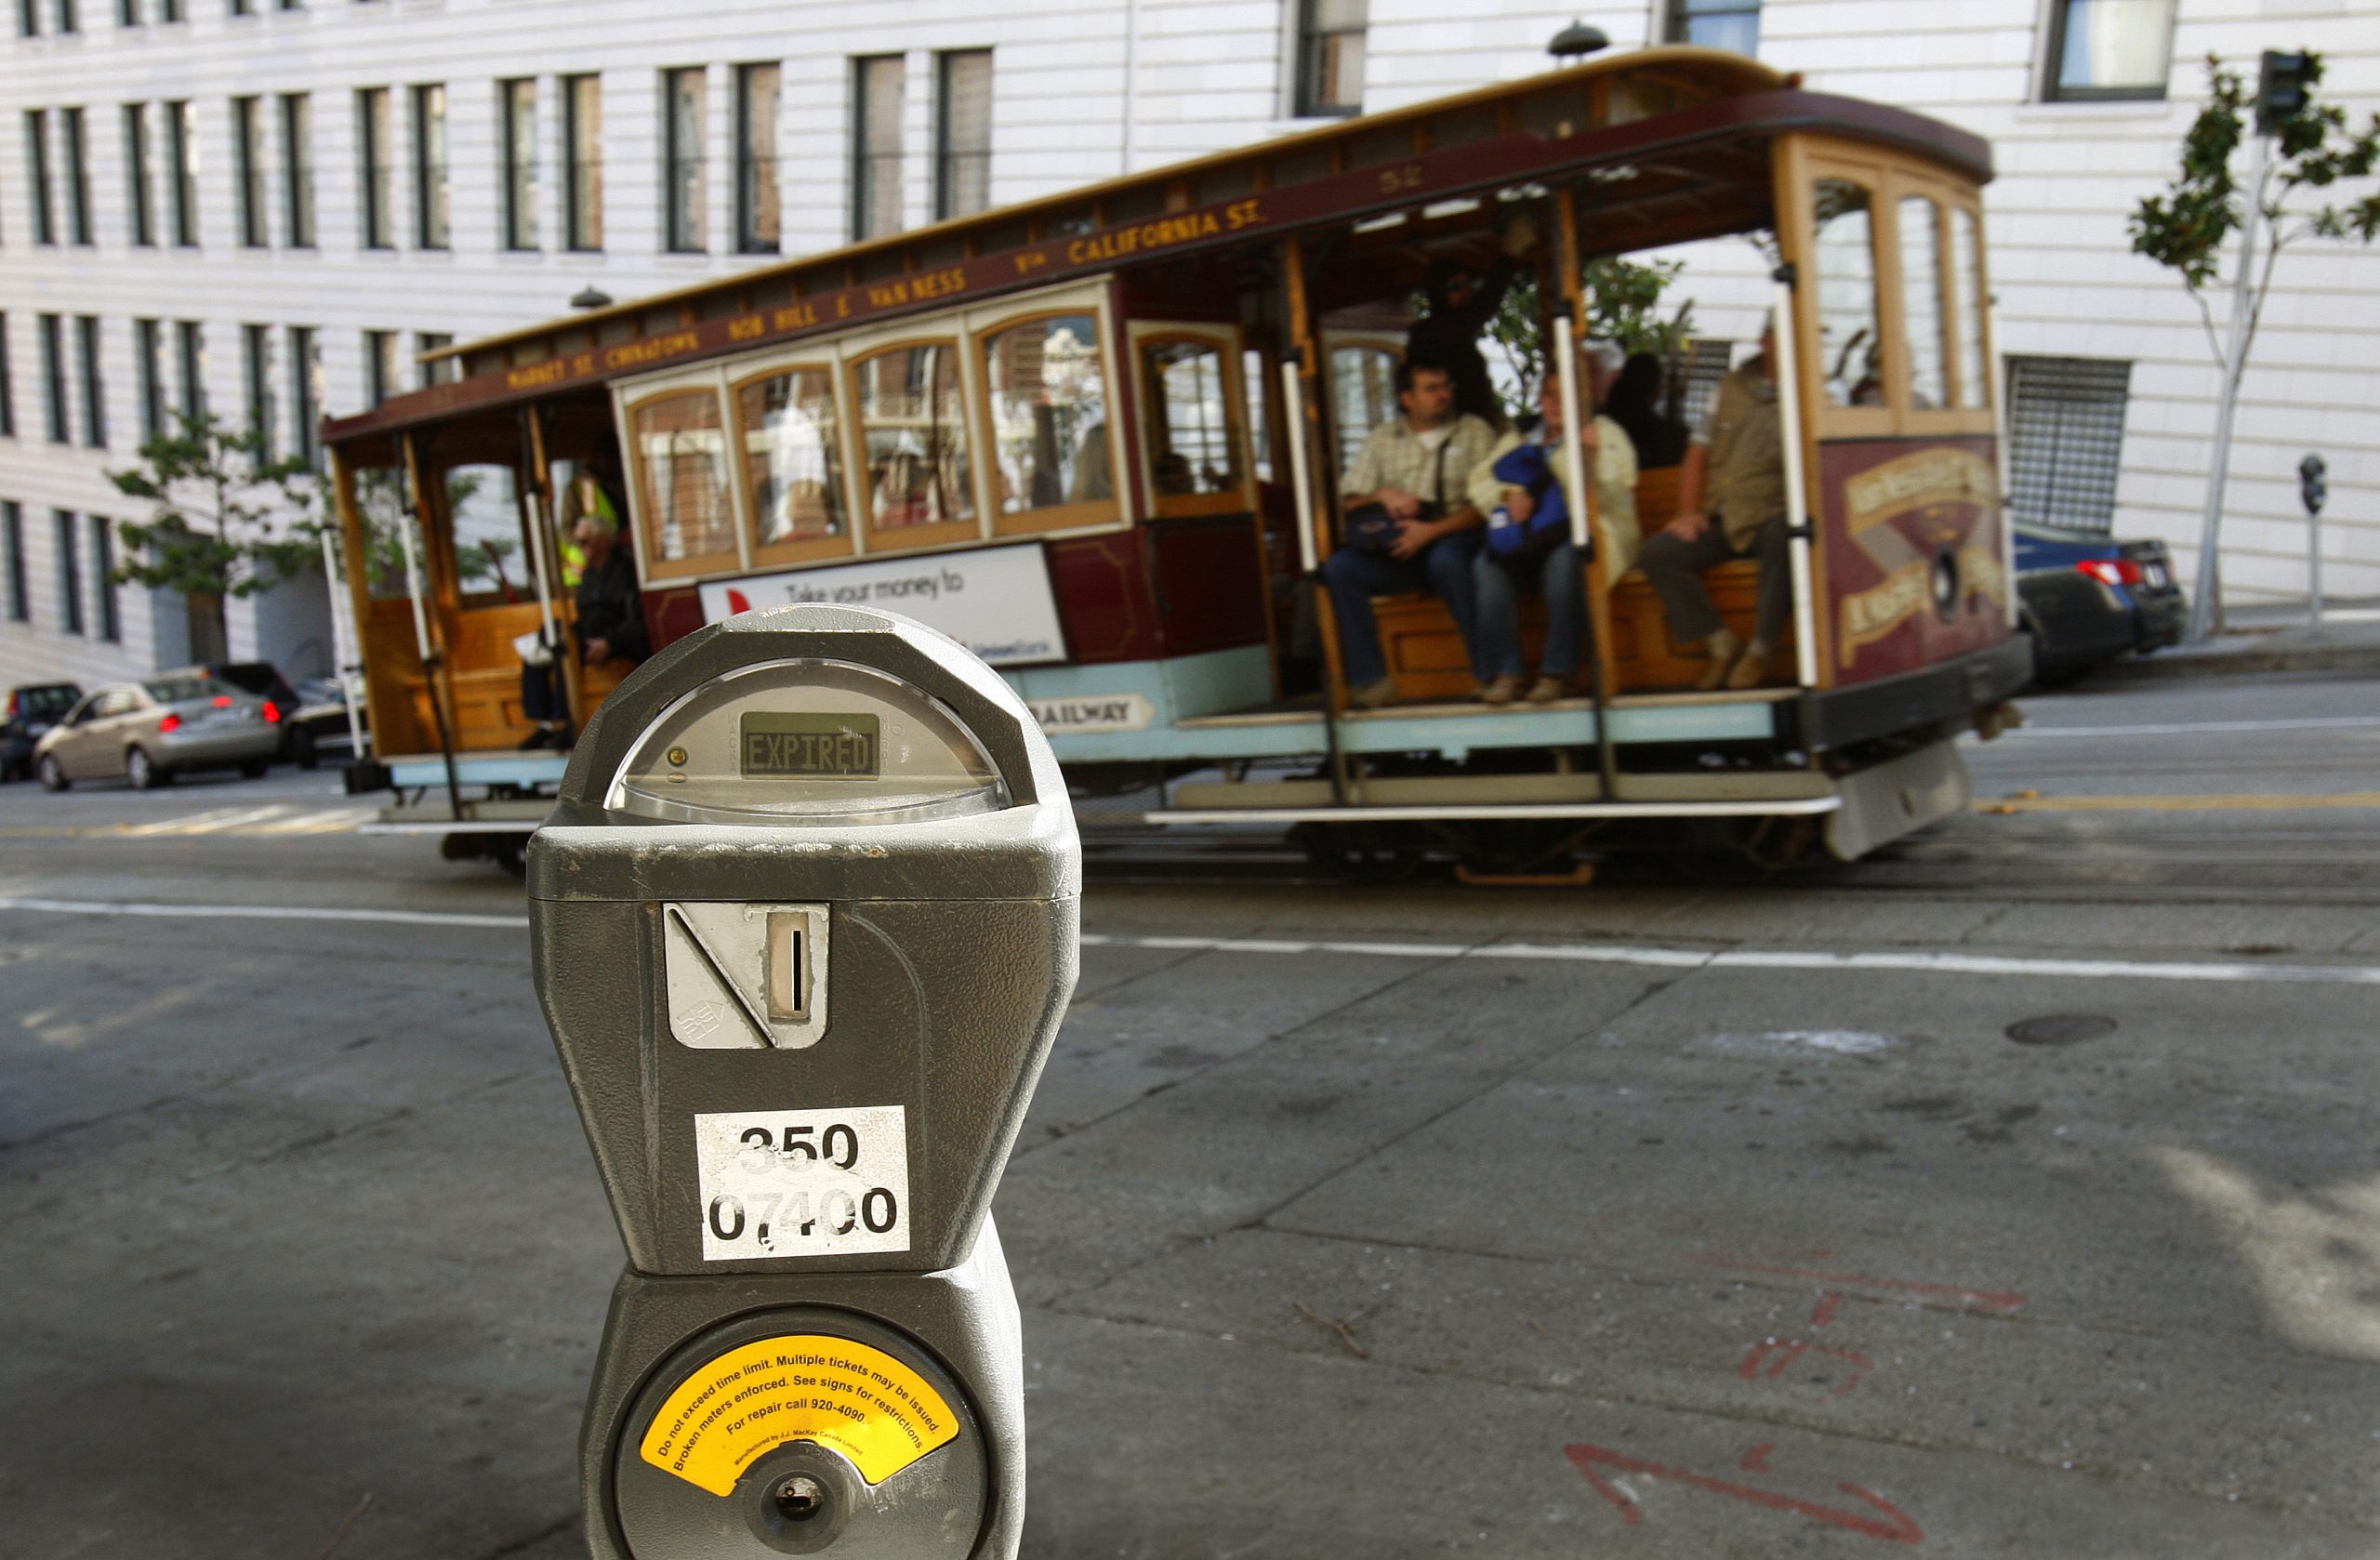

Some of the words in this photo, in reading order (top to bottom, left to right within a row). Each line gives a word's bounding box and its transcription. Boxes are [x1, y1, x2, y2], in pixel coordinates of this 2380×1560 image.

[774, 301, 818, 330] HILL
[867, 282, 908, 307] VAN
[911, 267, 967, 299] NESS
[1068, 213, 1220, 264] CALIFORNIA
[832, 583, 870, 602] your
[874, 575, 939, 600] money
[940, 567, 964, 592] to
[748, 734, 868, 771] EXPIRED
[740, 1123, 859, 1175] 350
[658, 1440, 671, 1457] Do
[669, 1419, 685, 1439] not
[682, 1384, 716, 1420] exceed
[716, 1371, 741, 1389] time
[743, 1360, 773, 1376] limit.
[776, 1355, 826, 1367] Multiple
[829, 1357, 868, 1376] tickets
[871, 1372, 895, 1390] may
[895, 1385, 908, 1400] be
[908, 1396, 939, 1434] issued.
[673, 1431, 701, 1472] Broken
[699, 1400, 733, 1432] meters
[734, 1377, 789, 1403] enforced.
[793, 1375, 816, 1385] See
[820, 1377, 853, 1393] signs
[856, 1386, 874, 1400] for
[874, 1397, 923, 1452] restrictions.
[726, 1418, 746, 1435] For
[747, 1402, 782, 1421] repair
[786, 1398, 808, 1409] call
[734, 1437, 770, 1465] Manufactured
